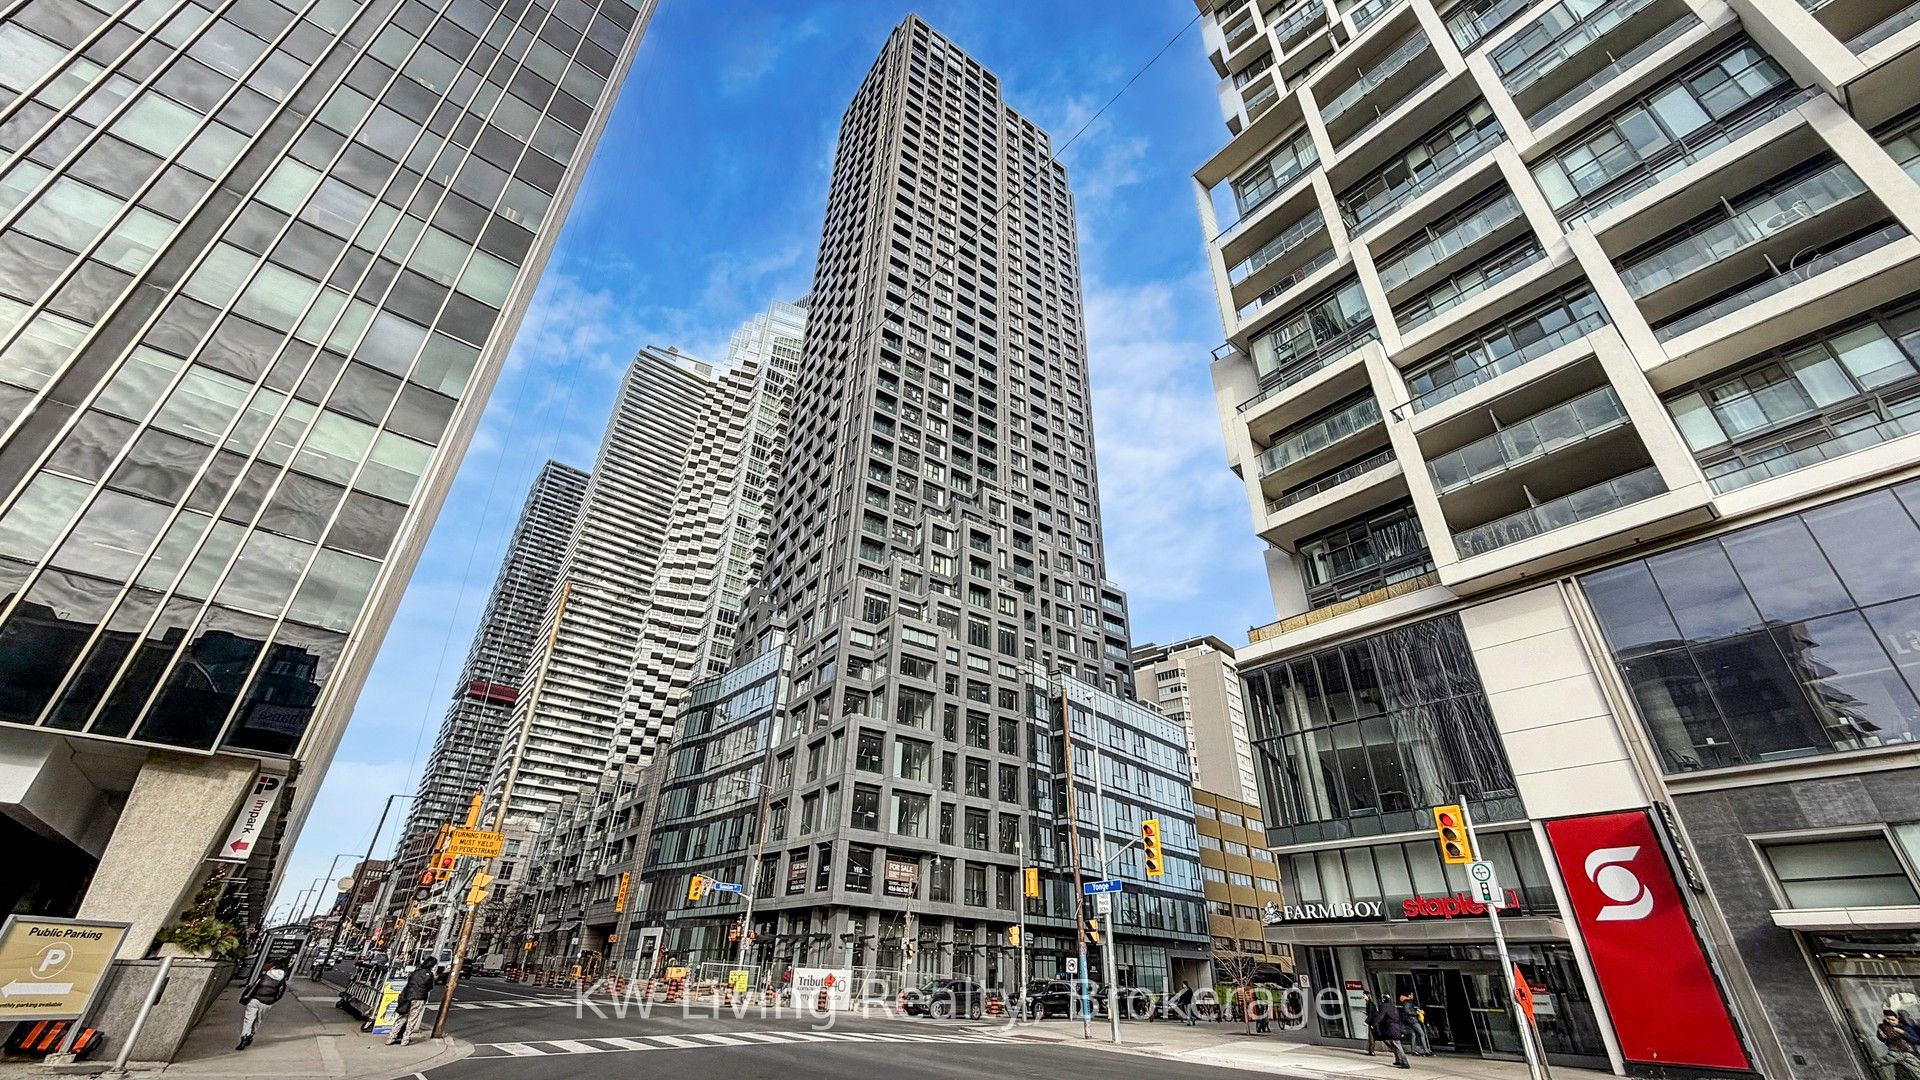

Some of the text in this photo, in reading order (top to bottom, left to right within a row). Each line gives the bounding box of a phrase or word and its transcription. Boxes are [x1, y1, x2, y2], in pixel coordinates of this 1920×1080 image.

[242, 799, 268, 834] impark
[454, 830, 479, 839] TURNING
[459, 838, 495, 848] MUST YIELD
[459, 846, 498, 855] PEDESTRIANS
[889, 863, 913, 873] FOR SALE
[1092, 882, 1109, 892] Yonge
[1283, 901, 1383, 920] FARM BOY
[1402, 892, 1501, 919] staple
[28, 927, 103, 941] Public Parking
[39, 949, 66, 972] P
[798, 974, 829, 987] Tribut
[15, 1001, 38, 1009] parking
